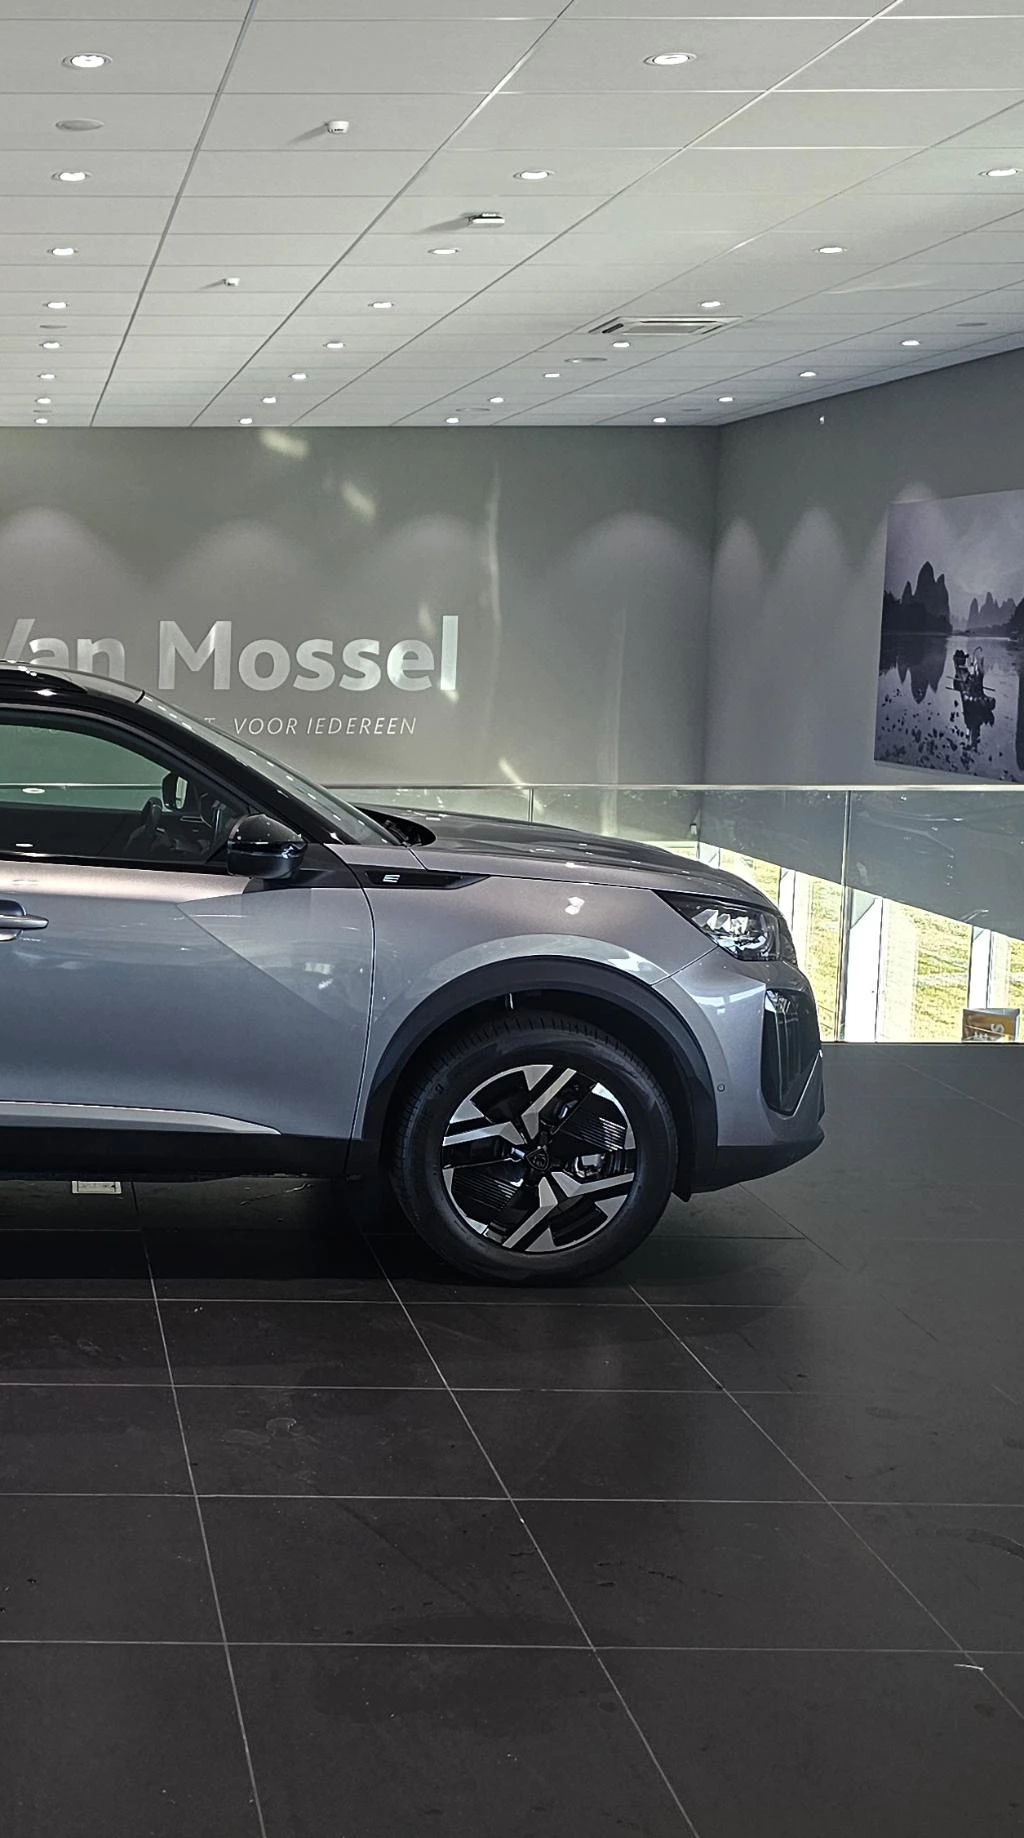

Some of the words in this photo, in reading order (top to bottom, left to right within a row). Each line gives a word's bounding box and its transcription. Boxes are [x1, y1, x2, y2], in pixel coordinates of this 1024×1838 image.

[158, 615, 458, 691] Mossel
[232, 717, 298, 735] VOOR
[306, 717, 417, 735] IEDEREEN
